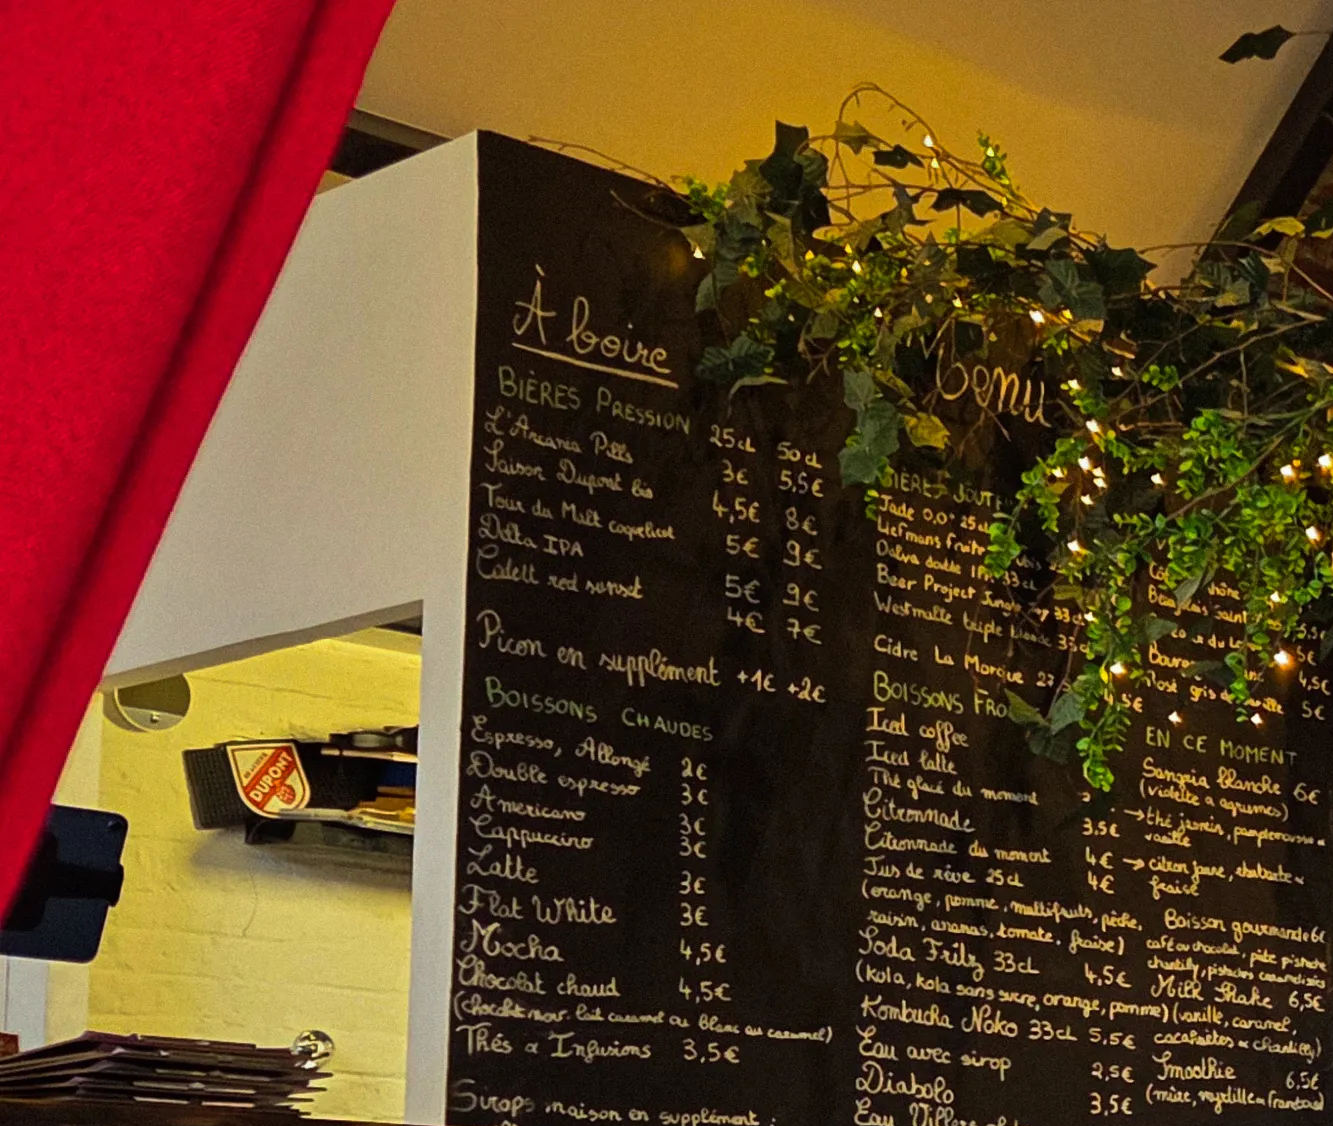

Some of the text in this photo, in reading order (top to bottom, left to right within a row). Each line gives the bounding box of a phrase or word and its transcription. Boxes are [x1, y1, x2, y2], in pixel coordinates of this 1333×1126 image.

[512, 263, 672, 374] À boire
[499, 365, 691, 435] BIÈRES PRESSION
[722, 460, 748, 485] 3€
[785, 506, 818, 536] 8€
[542, 533, 584, 558] IPA
[726, 534, 823, 570] 5€ 9€
[724, 575, 820, 612] 5€ 9€
[924, 574, 977, 603] Project
[727, 606, 822, 645] 4€ 7€
[599, 649, 722, 688] supplément
[874, 634, 955, 666] Cidre La
[485, 675, 714, 742] BOISSONS CHAUDES
[873, 670, 964, 714] BOISSONS
[866, 706, 969, 752] Iced coffee
[1146, 726, 1298, 766] EN CE MOMENT
[575, 736, 708, 780] Allongé 2€
[864, 740, 910, 766] Iced
[249, 751, 293, 802] DUPONT
[466, 750, 709, 805] Double espresso 3€
[1293, 782, 1321, 805] 6€
[470, 785, 706, 835] Americano 3€
[863, 788, 975, 833] Citronnade
[470, 813, 706, 859] Cappuccino 3€
[968, 840, 988, 858] du
[1086, 848, 1114, 869] 4€
[466, 844, 706, 895] Latte 3€
[863, 856, 1115, 894] Jus de 4€
[458, 883, 709, 927] Flat White 3€
[1165, 908, 1226, 932] Boisson
[460, 919, 727, 965] Mocha 4,5€
[859, 925, 915, 962] Soda
[1084, 963, 1132, 988] 4,5€
[456, 955, 732, 1004] Chocolat chaud 4,5€
[1150, 974, 1204, 1000] Milk
[1288, 991, 1326, 1012] 6,5€
[860, 994, 1078, 1042] Kombucha 33cl
[455, 1021, 741, 1066] Thés Infusions 3,5€
[856, 1025, 899, 1061] Eau
[961, 1052, 1011, 1081] sirop
[1152, 1051, 1237, 1081] Smoothie
[856, 1061, 1133, 1116] Diabolo 3,5€
